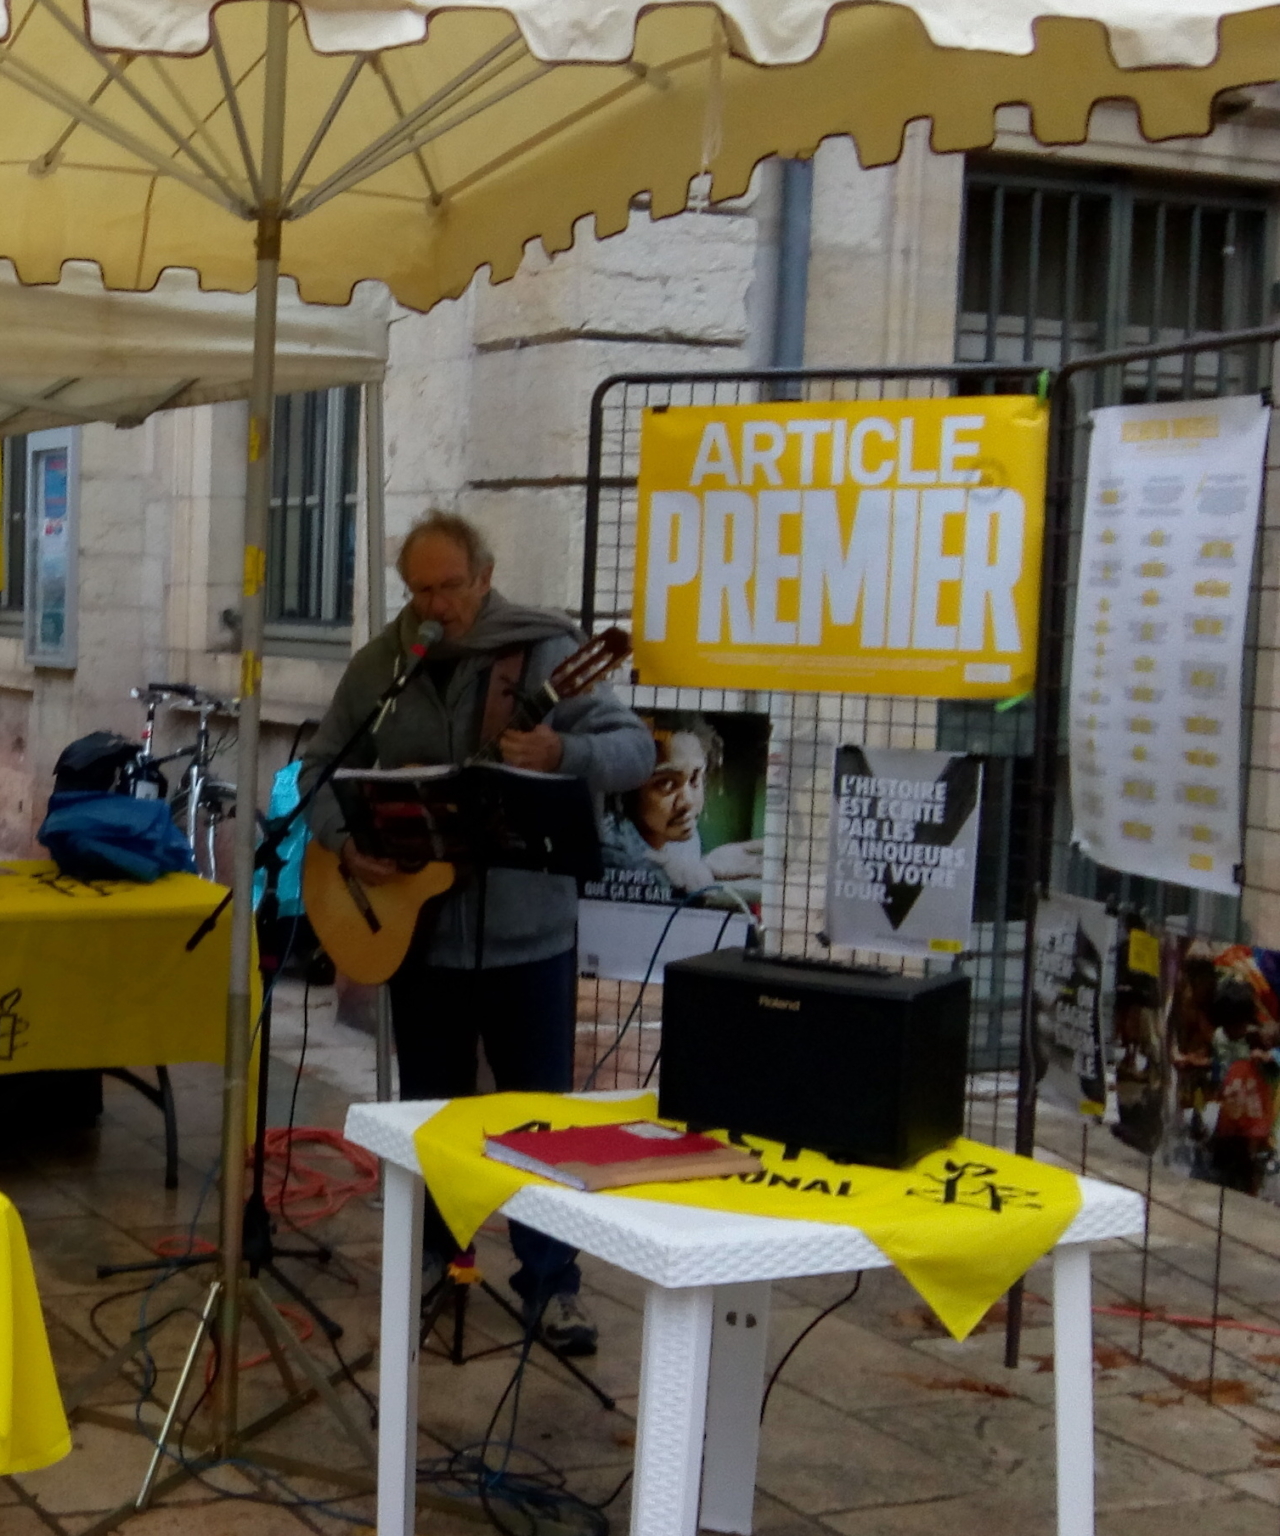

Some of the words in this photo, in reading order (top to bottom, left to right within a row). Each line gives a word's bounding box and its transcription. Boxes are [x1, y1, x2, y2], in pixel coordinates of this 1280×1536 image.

[689, 415, 985, 487] ARTICLE
[643, 488, 1026, 652] PREMIER
[840, 774, 948, 801] L'HISTOIRE
[838, 796, 872, 819] EST
[837, 816, 877, 838] PAR
[882, 820, 916, 842] LES
[837, 837, 966, 868] VAINQUEURS
[891, 862, 957, 889] VOTRE
